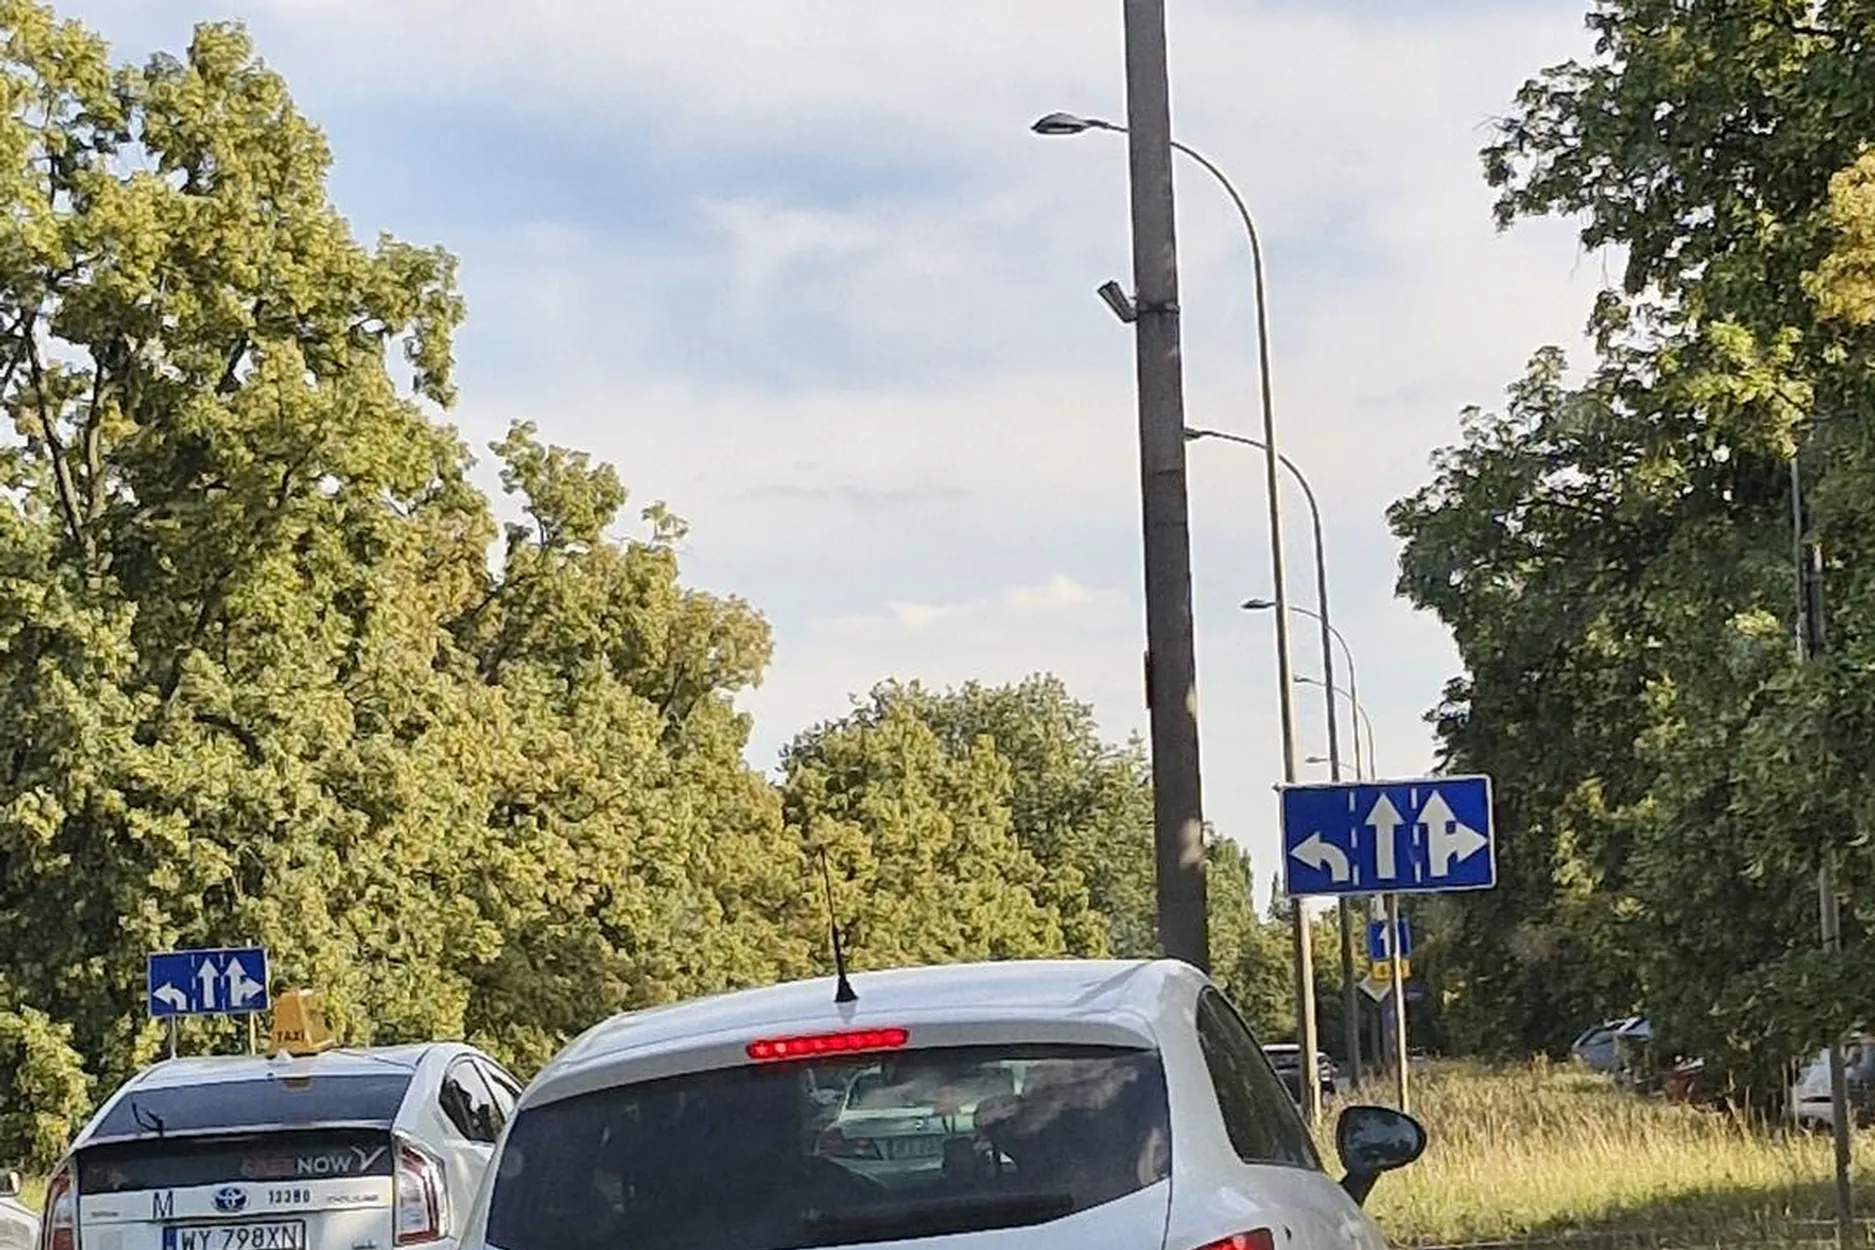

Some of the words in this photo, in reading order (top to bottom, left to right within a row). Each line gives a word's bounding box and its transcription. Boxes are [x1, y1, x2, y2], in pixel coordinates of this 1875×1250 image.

[272, 1029, 305, 1044] TAXI
[297, 1154, 351, 1175] NOW
[153, 1191, 174, 1220] M
